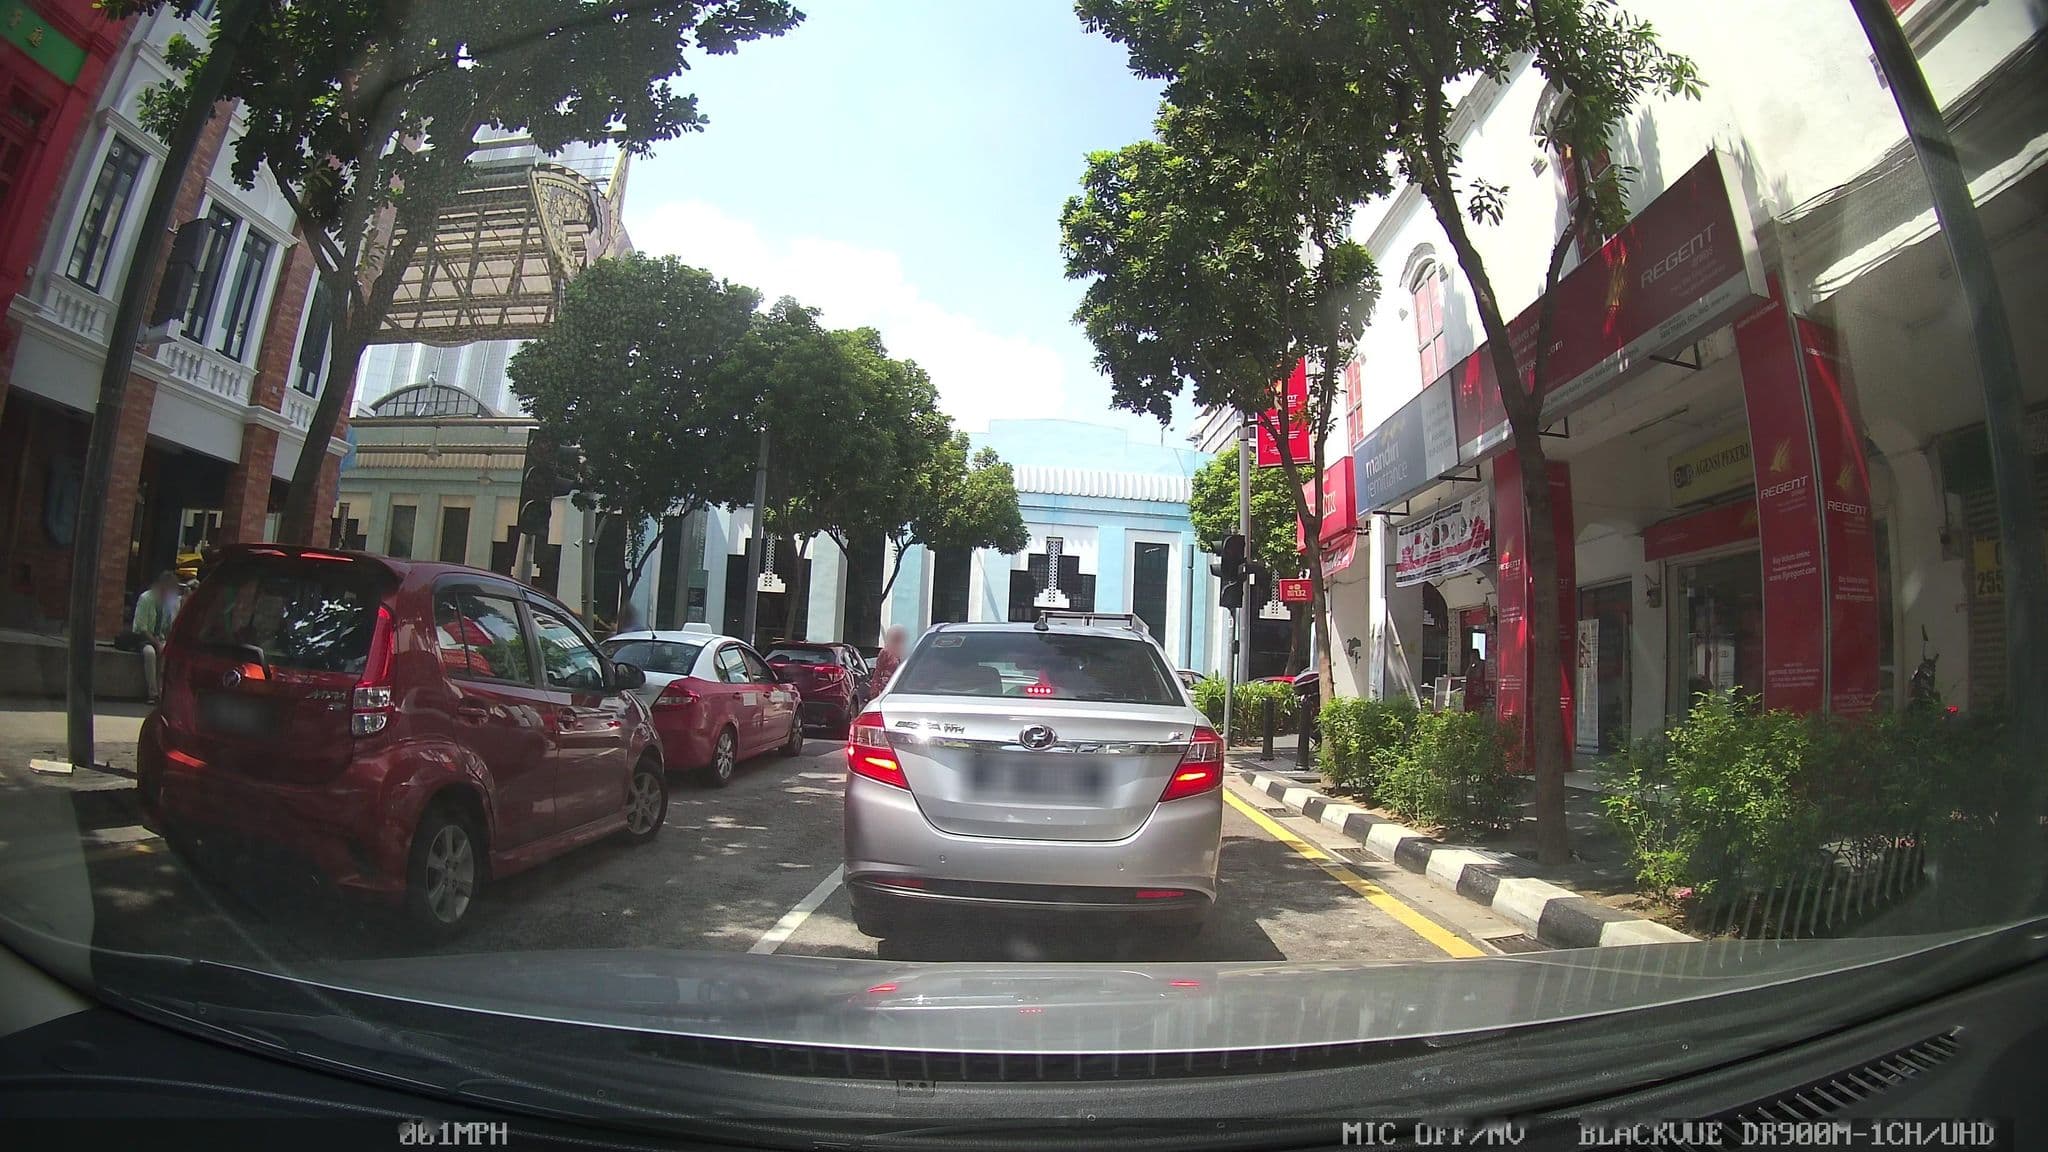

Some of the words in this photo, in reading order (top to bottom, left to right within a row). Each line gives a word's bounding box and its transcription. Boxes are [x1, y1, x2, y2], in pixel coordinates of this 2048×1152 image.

[1641, 222, 1716, 289] REGENT
[1761, 475, 1808, 499] REGENT
[1827, 500, 1866, 514] REGENT
